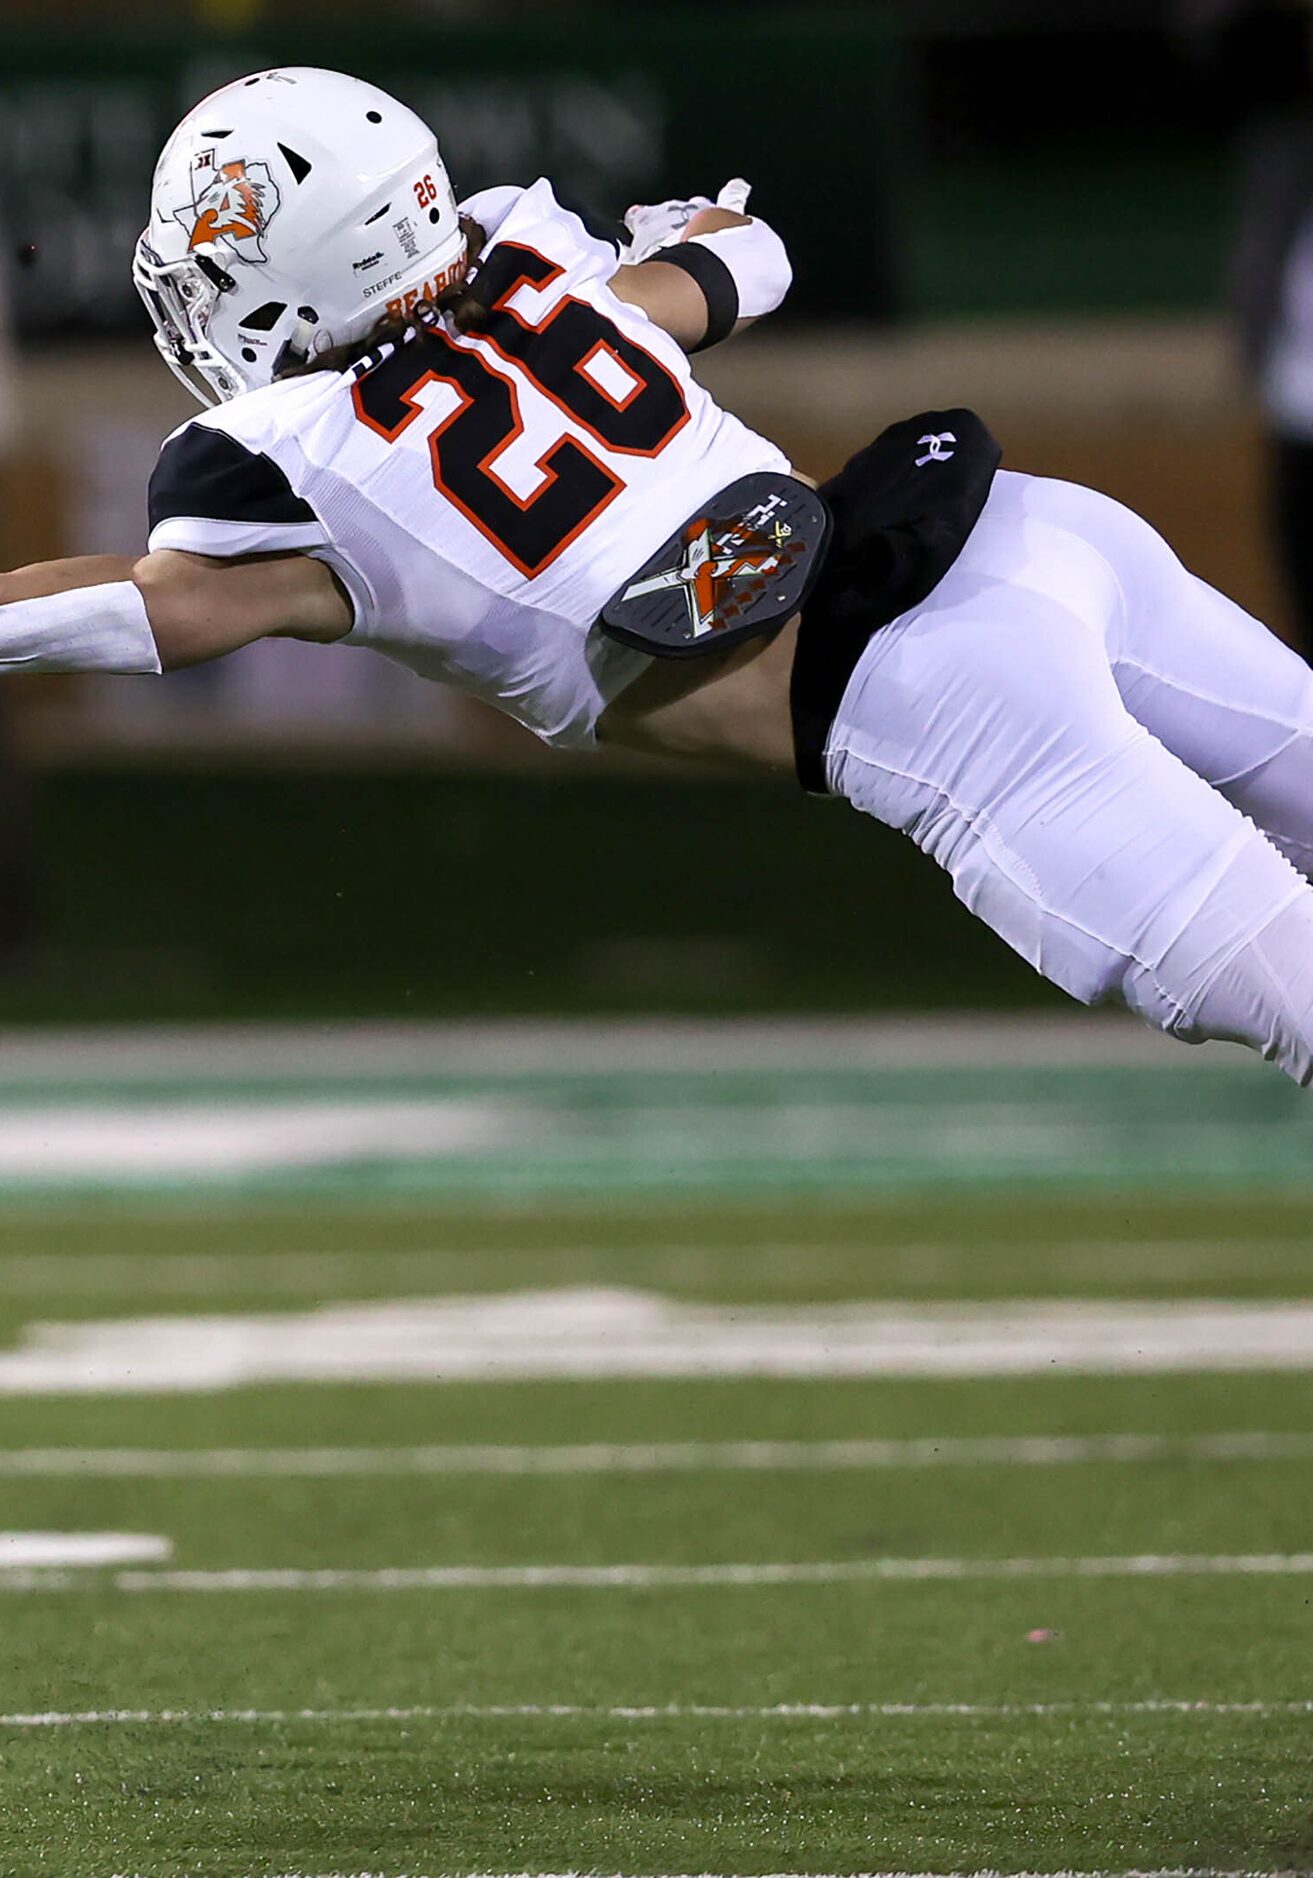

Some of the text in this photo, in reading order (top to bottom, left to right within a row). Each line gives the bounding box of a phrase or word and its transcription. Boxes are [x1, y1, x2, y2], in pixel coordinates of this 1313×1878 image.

[413, 174, 437, 209] 26
[362, 271, 402, 298] STEFFE
[351, 240, 692, 580] 26
